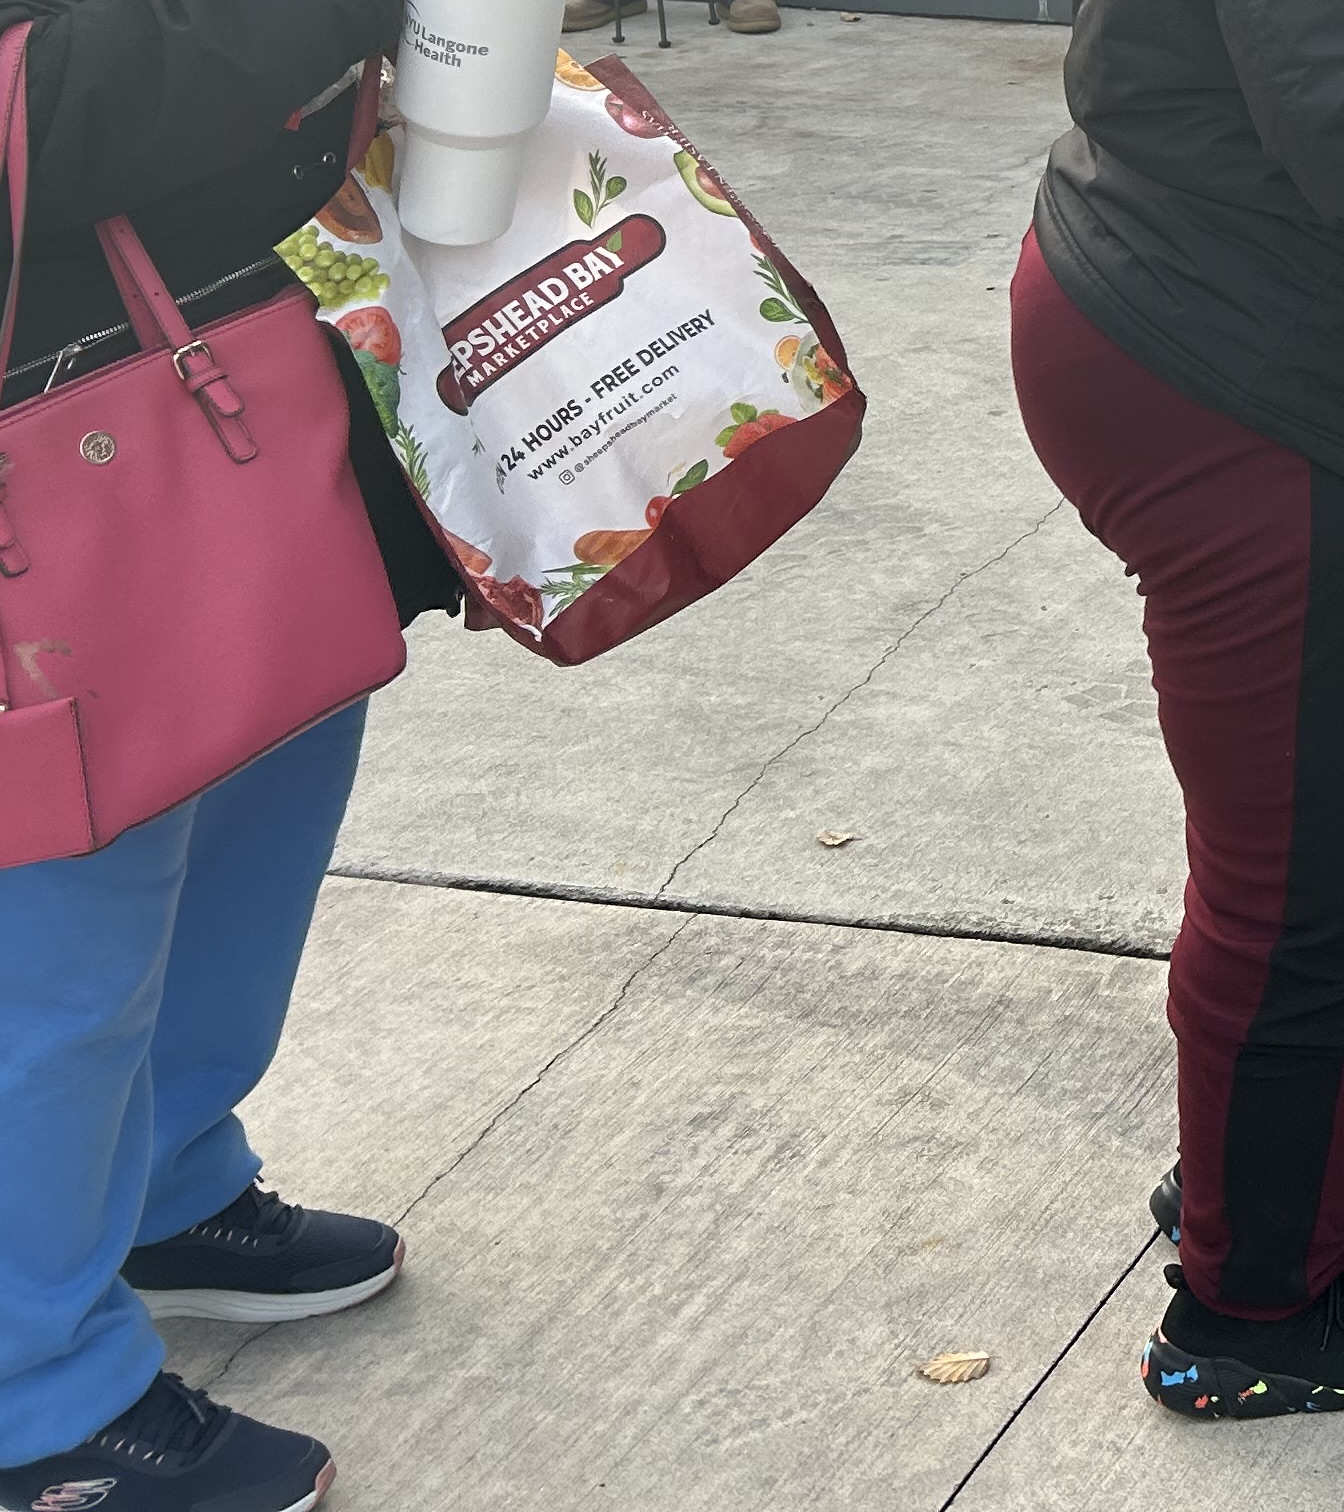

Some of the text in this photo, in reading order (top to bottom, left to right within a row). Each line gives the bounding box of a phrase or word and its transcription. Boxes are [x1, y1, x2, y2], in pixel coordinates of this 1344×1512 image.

[415, 39, 462, 68] Health
[421, 26, 489, 56] Langone
[562, 246, 625, 291] BAY
[466, 292, 594, 387] MARKETPLACE
[501, 446, 526, 471] 24
[522, 399, 583, 453] HOURS
[590, 358, 640, 399] FREE
[635, 309, 716, 367] DELIVERY
[527, 364, 680, 481] www.bayfruit.com
